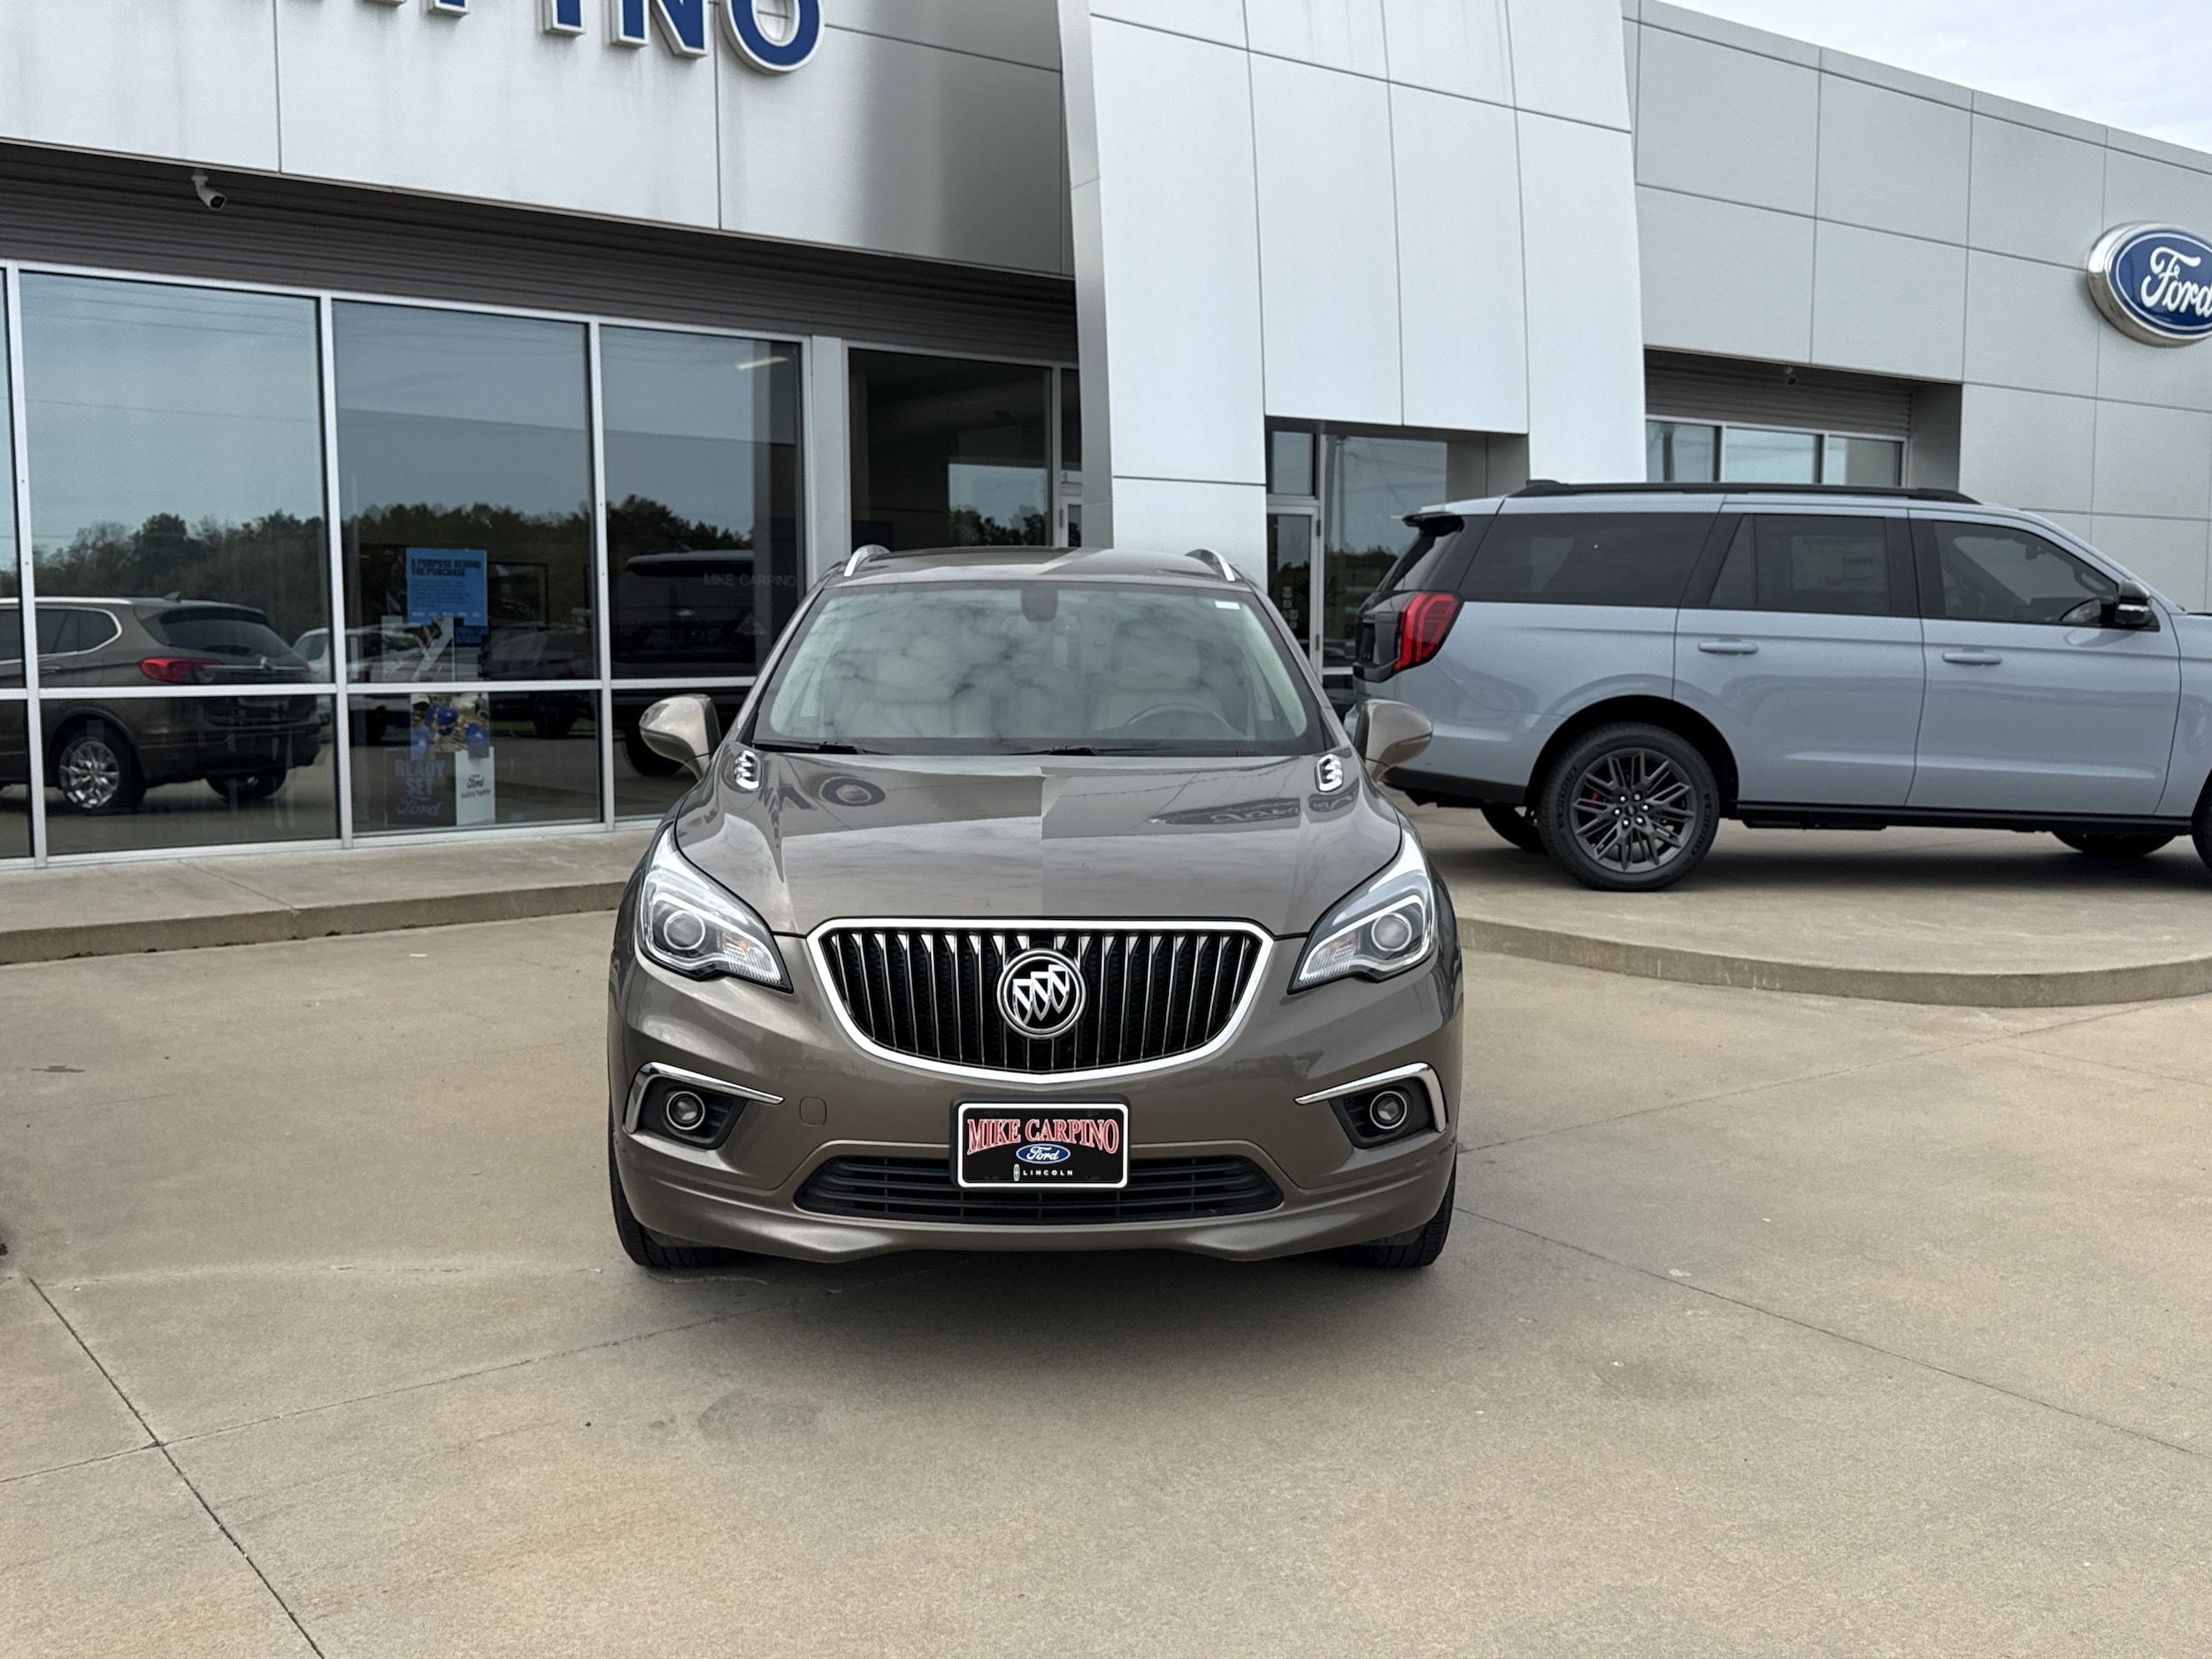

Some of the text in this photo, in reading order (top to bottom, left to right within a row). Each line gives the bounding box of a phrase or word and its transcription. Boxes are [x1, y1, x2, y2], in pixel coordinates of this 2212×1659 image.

[703, 573, 734, 587] MIKE
[395, 759, 445, 779] READY
[406, 779, 434, 795] SET
[396, 795, 444, 816] Ford
[967, 1118, 1119, 1156] MIKE CARPINO
[1025, 1146, 1060, 1161] Ford
